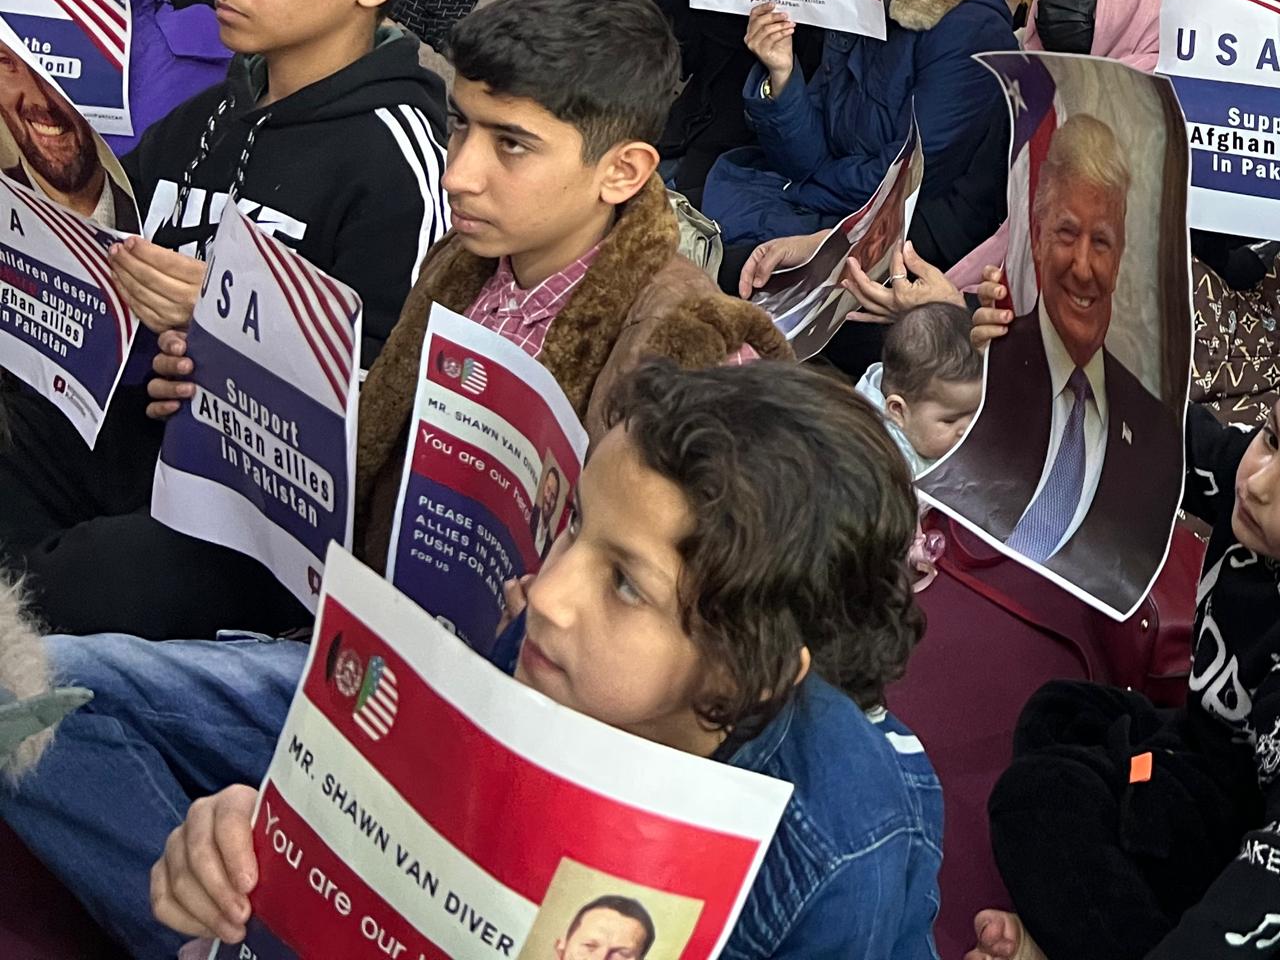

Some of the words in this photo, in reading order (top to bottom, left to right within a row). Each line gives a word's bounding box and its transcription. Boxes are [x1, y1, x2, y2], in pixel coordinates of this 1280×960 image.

[1177, 28, 1280, 72] USA
[1191, 126, 1276, 155] Afghan
[42, 291, 93, 330] support
[53, 272, 106, 314] deserve
[15, 314, 67, 357] Pakistan
[41, 310, 79, 342] allies
[199, 391, 265, 456] Afghan
[226, 378, 299, 447] Support
[428, 398, 450, 416] MR.
[455, 411, 499, 441] SHAWN
[503, 437, 521, 461] VAN
[422, 429, 452, 455] You
[459, 451, 485, 471] are
[414, 530, 454, 557] PUSH
[416, 515, 469, 546] ALLIES
[411, 549, 433, 564] FOR
[436, 561, 450, 572] US
[259, 800, 304, 870] You
[309, 867, 353, 918] are
[287, 734, 315, 778] MR.
[321, 774, 391, 854] SHAWN
[393, 843, 440, 897] VAN
[444, 892, 515, 956] DIVER
